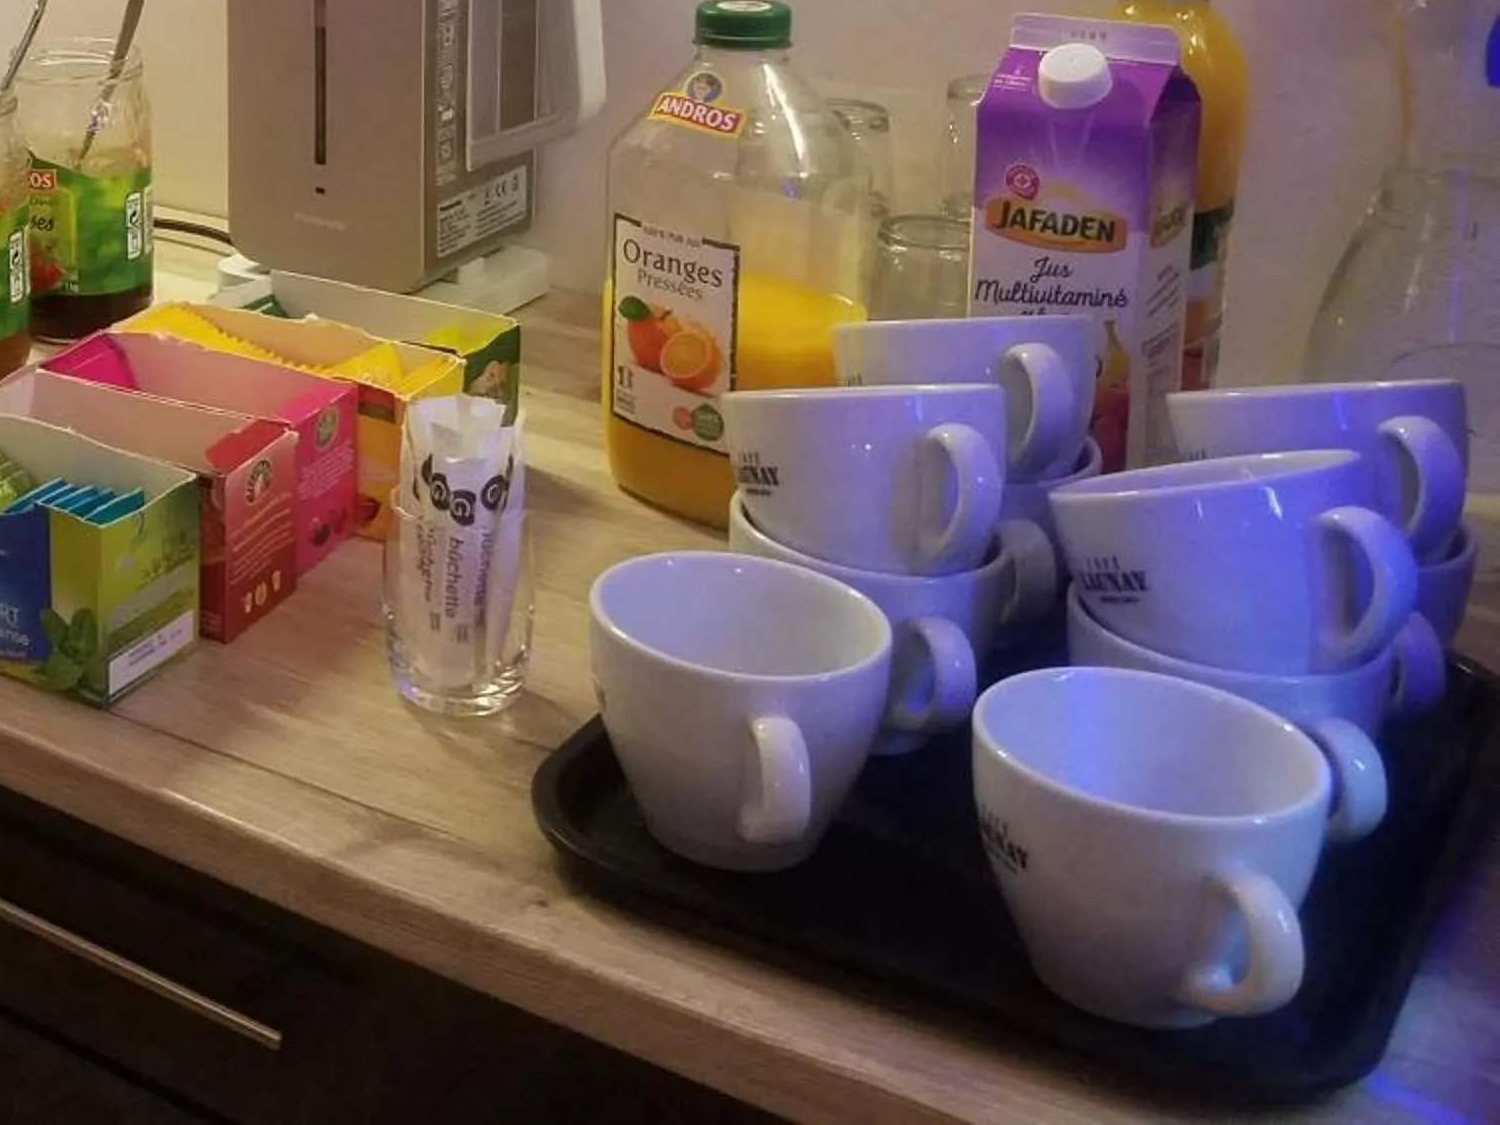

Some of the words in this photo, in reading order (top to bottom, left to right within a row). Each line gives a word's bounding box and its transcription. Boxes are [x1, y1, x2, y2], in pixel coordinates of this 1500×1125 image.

[656, 95, 738, 131] ANDROS
[994, 200, 1117, 243] JAFADEN
[622, 238, 724, 288] Oranges
[1028, 255, 1074, 284] Jus
[636, 267, 703, 300] Pressées
[974, 278, 1129, 309] Multivitaminé
